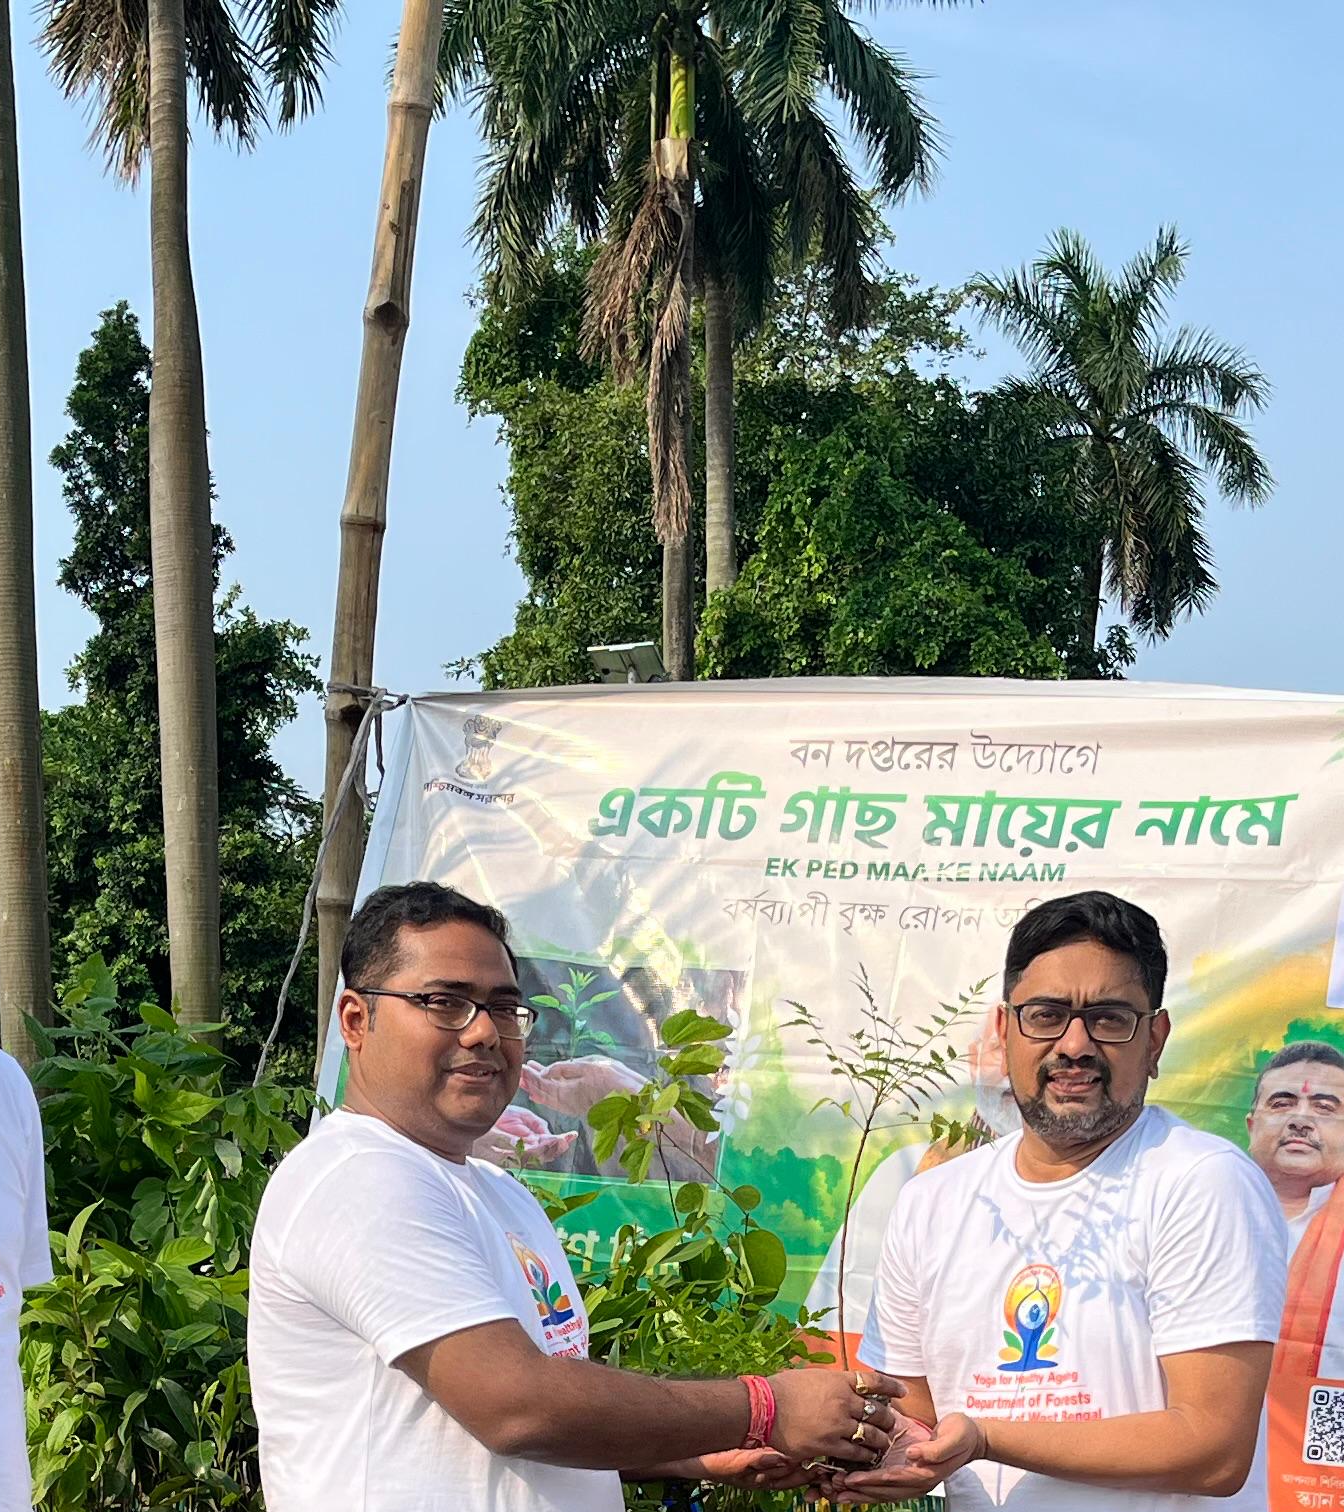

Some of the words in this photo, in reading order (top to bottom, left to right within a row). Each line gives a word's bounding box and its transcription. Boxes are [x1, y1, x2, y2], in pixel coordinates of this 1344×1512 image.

[790, 739, 832, 769] বন
[845, 736, 958, 772] দপ্তরের
[970, 729, 1103, 775] উদ্যোগে
[588, 771, 766, 841] একটি
[780, 785, 908, 849] গাছ
[922, 790, 1122, 857] মায়ের
[1135, 793, 1299, 846] নামে
[764, 857, 801, 877] EK
[806, 860, 859, 880] PED
[866, 861, 929, 882] MAA
[933, 862, 972, 882] KE
[978, 862, 1066, 882] NAAM
[838, 902, 890, 936] বৃক্ষ
[898, 904, 984, 933] রোপন
[973, 1374, 996, 1388] Yoga
[999, 1373, 1012, 1385] for
[1028, 1394, 1041, 1407] of
[1046, 1391, 1091, 1407] Forests
